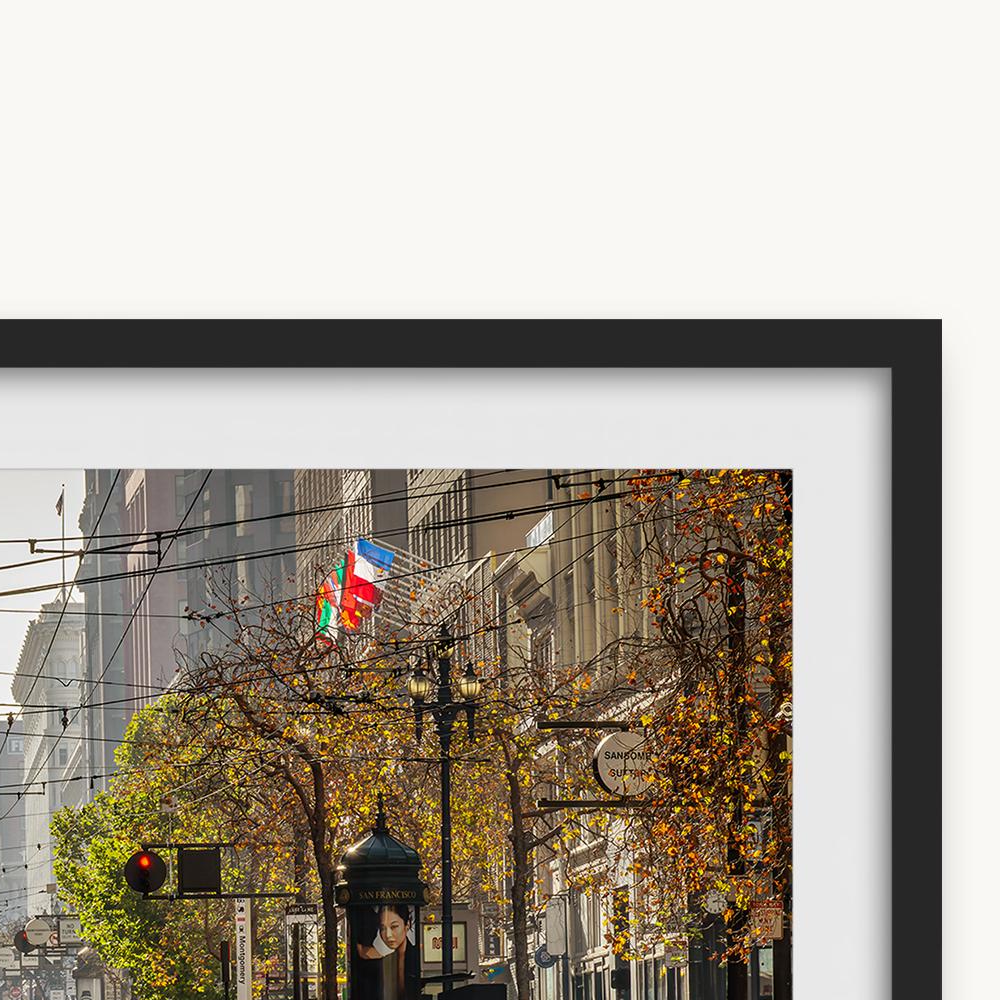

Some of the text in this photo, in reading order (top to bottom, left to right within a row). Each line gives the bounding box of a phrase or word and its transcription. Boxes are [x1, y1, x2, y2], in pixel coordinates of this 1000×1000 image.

[359, 890, 417, 900] SAN FRANCISCO
[237, 936, 247, 985] Montgomery
